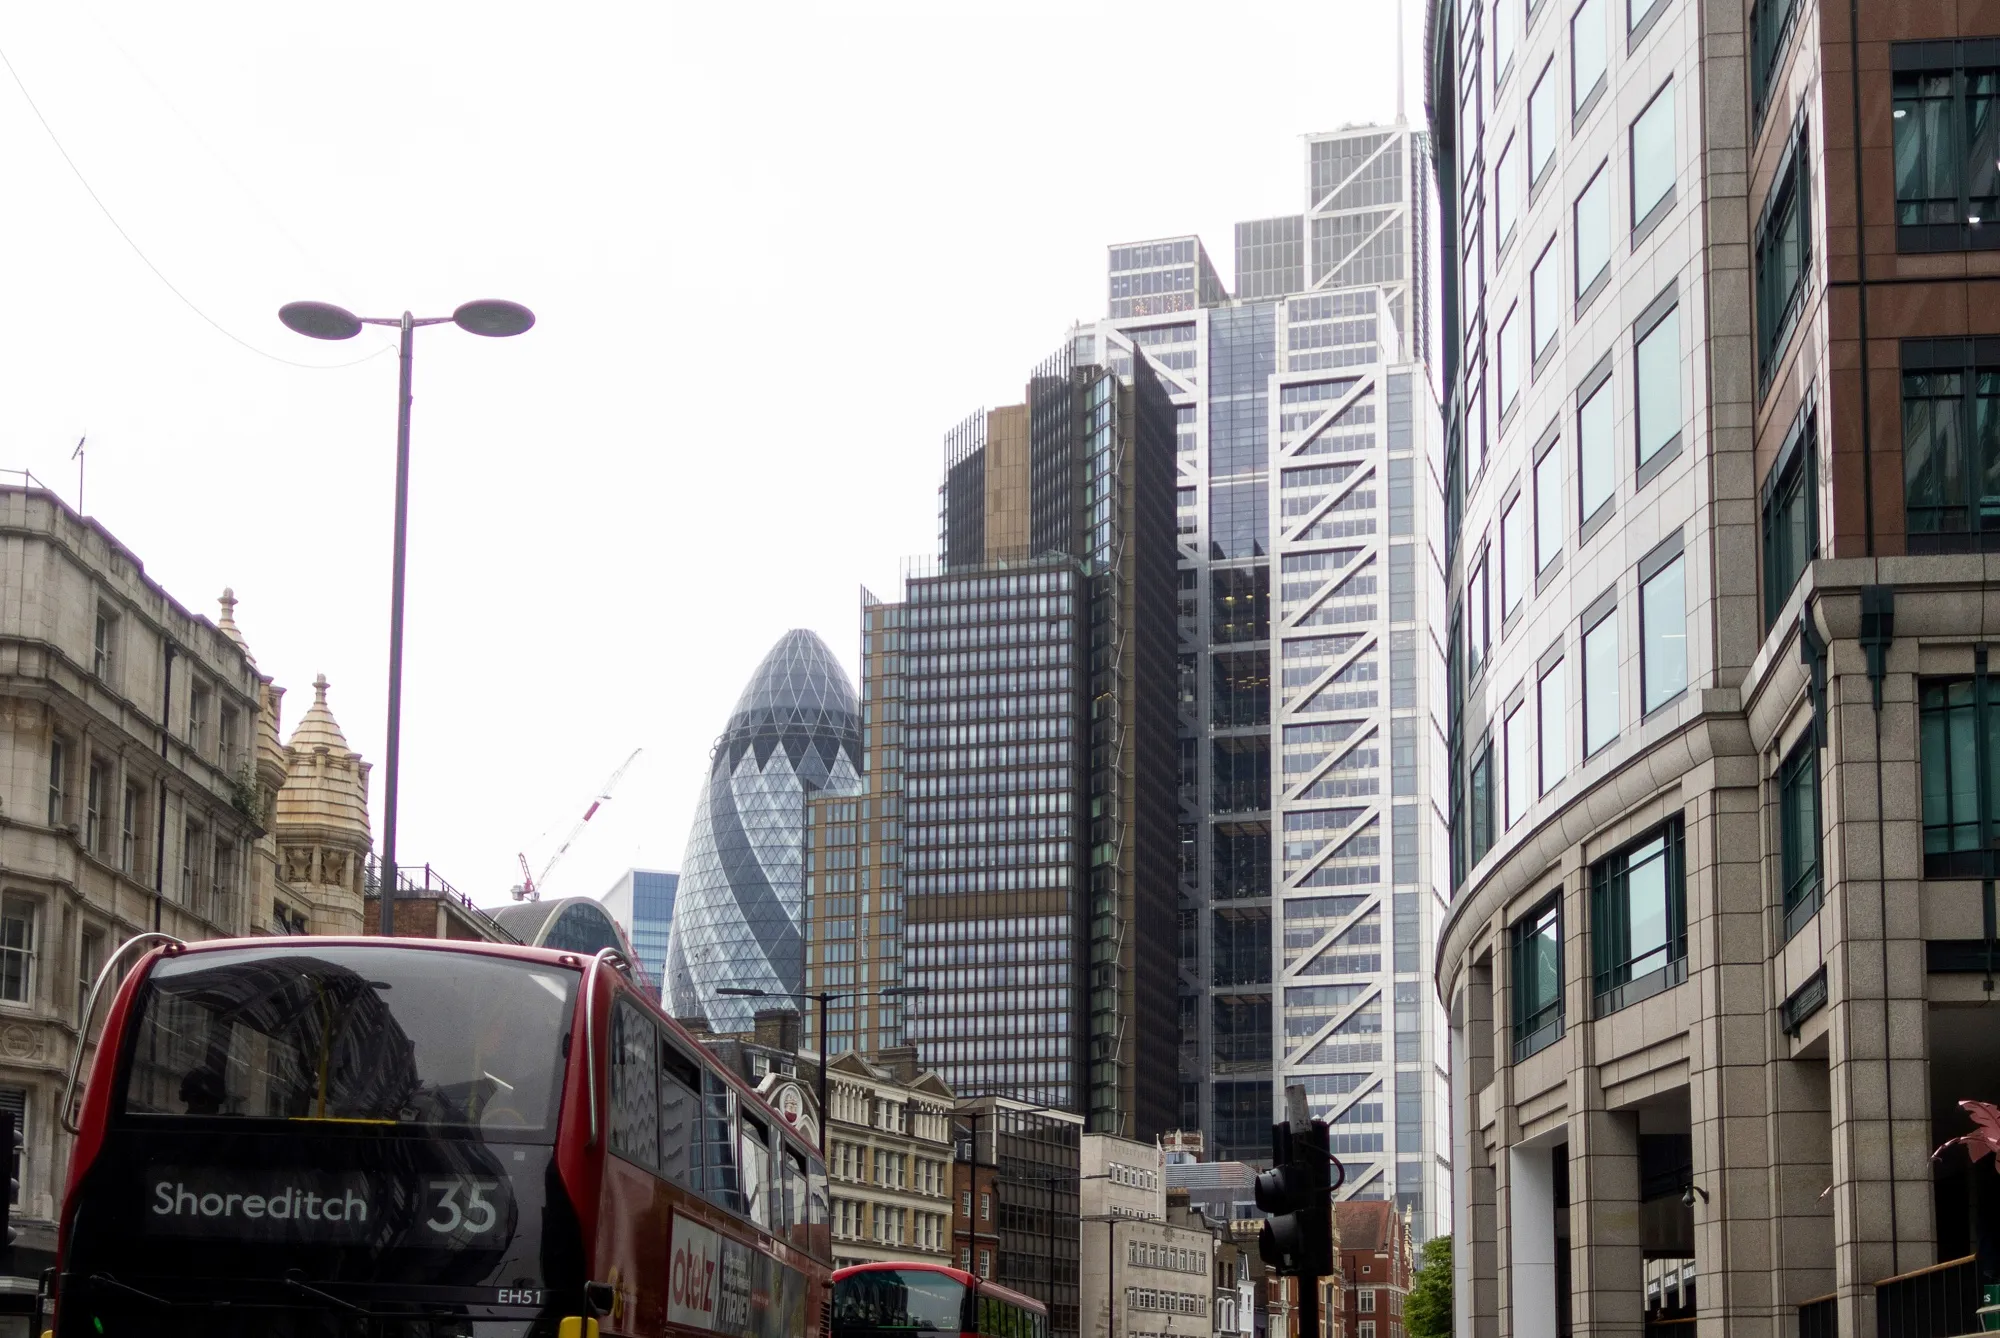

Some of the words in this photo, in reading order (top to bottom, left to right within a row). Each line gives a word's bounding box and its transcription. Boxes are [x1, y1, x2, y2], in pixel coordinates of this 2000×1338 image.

[152, 1181, 367, 1222] Shoreditch
[426, 1180, 498, 1233] 35
[497, 1289, 541, 1305] EH51
[673, 1238, 715, 1312] otelz
